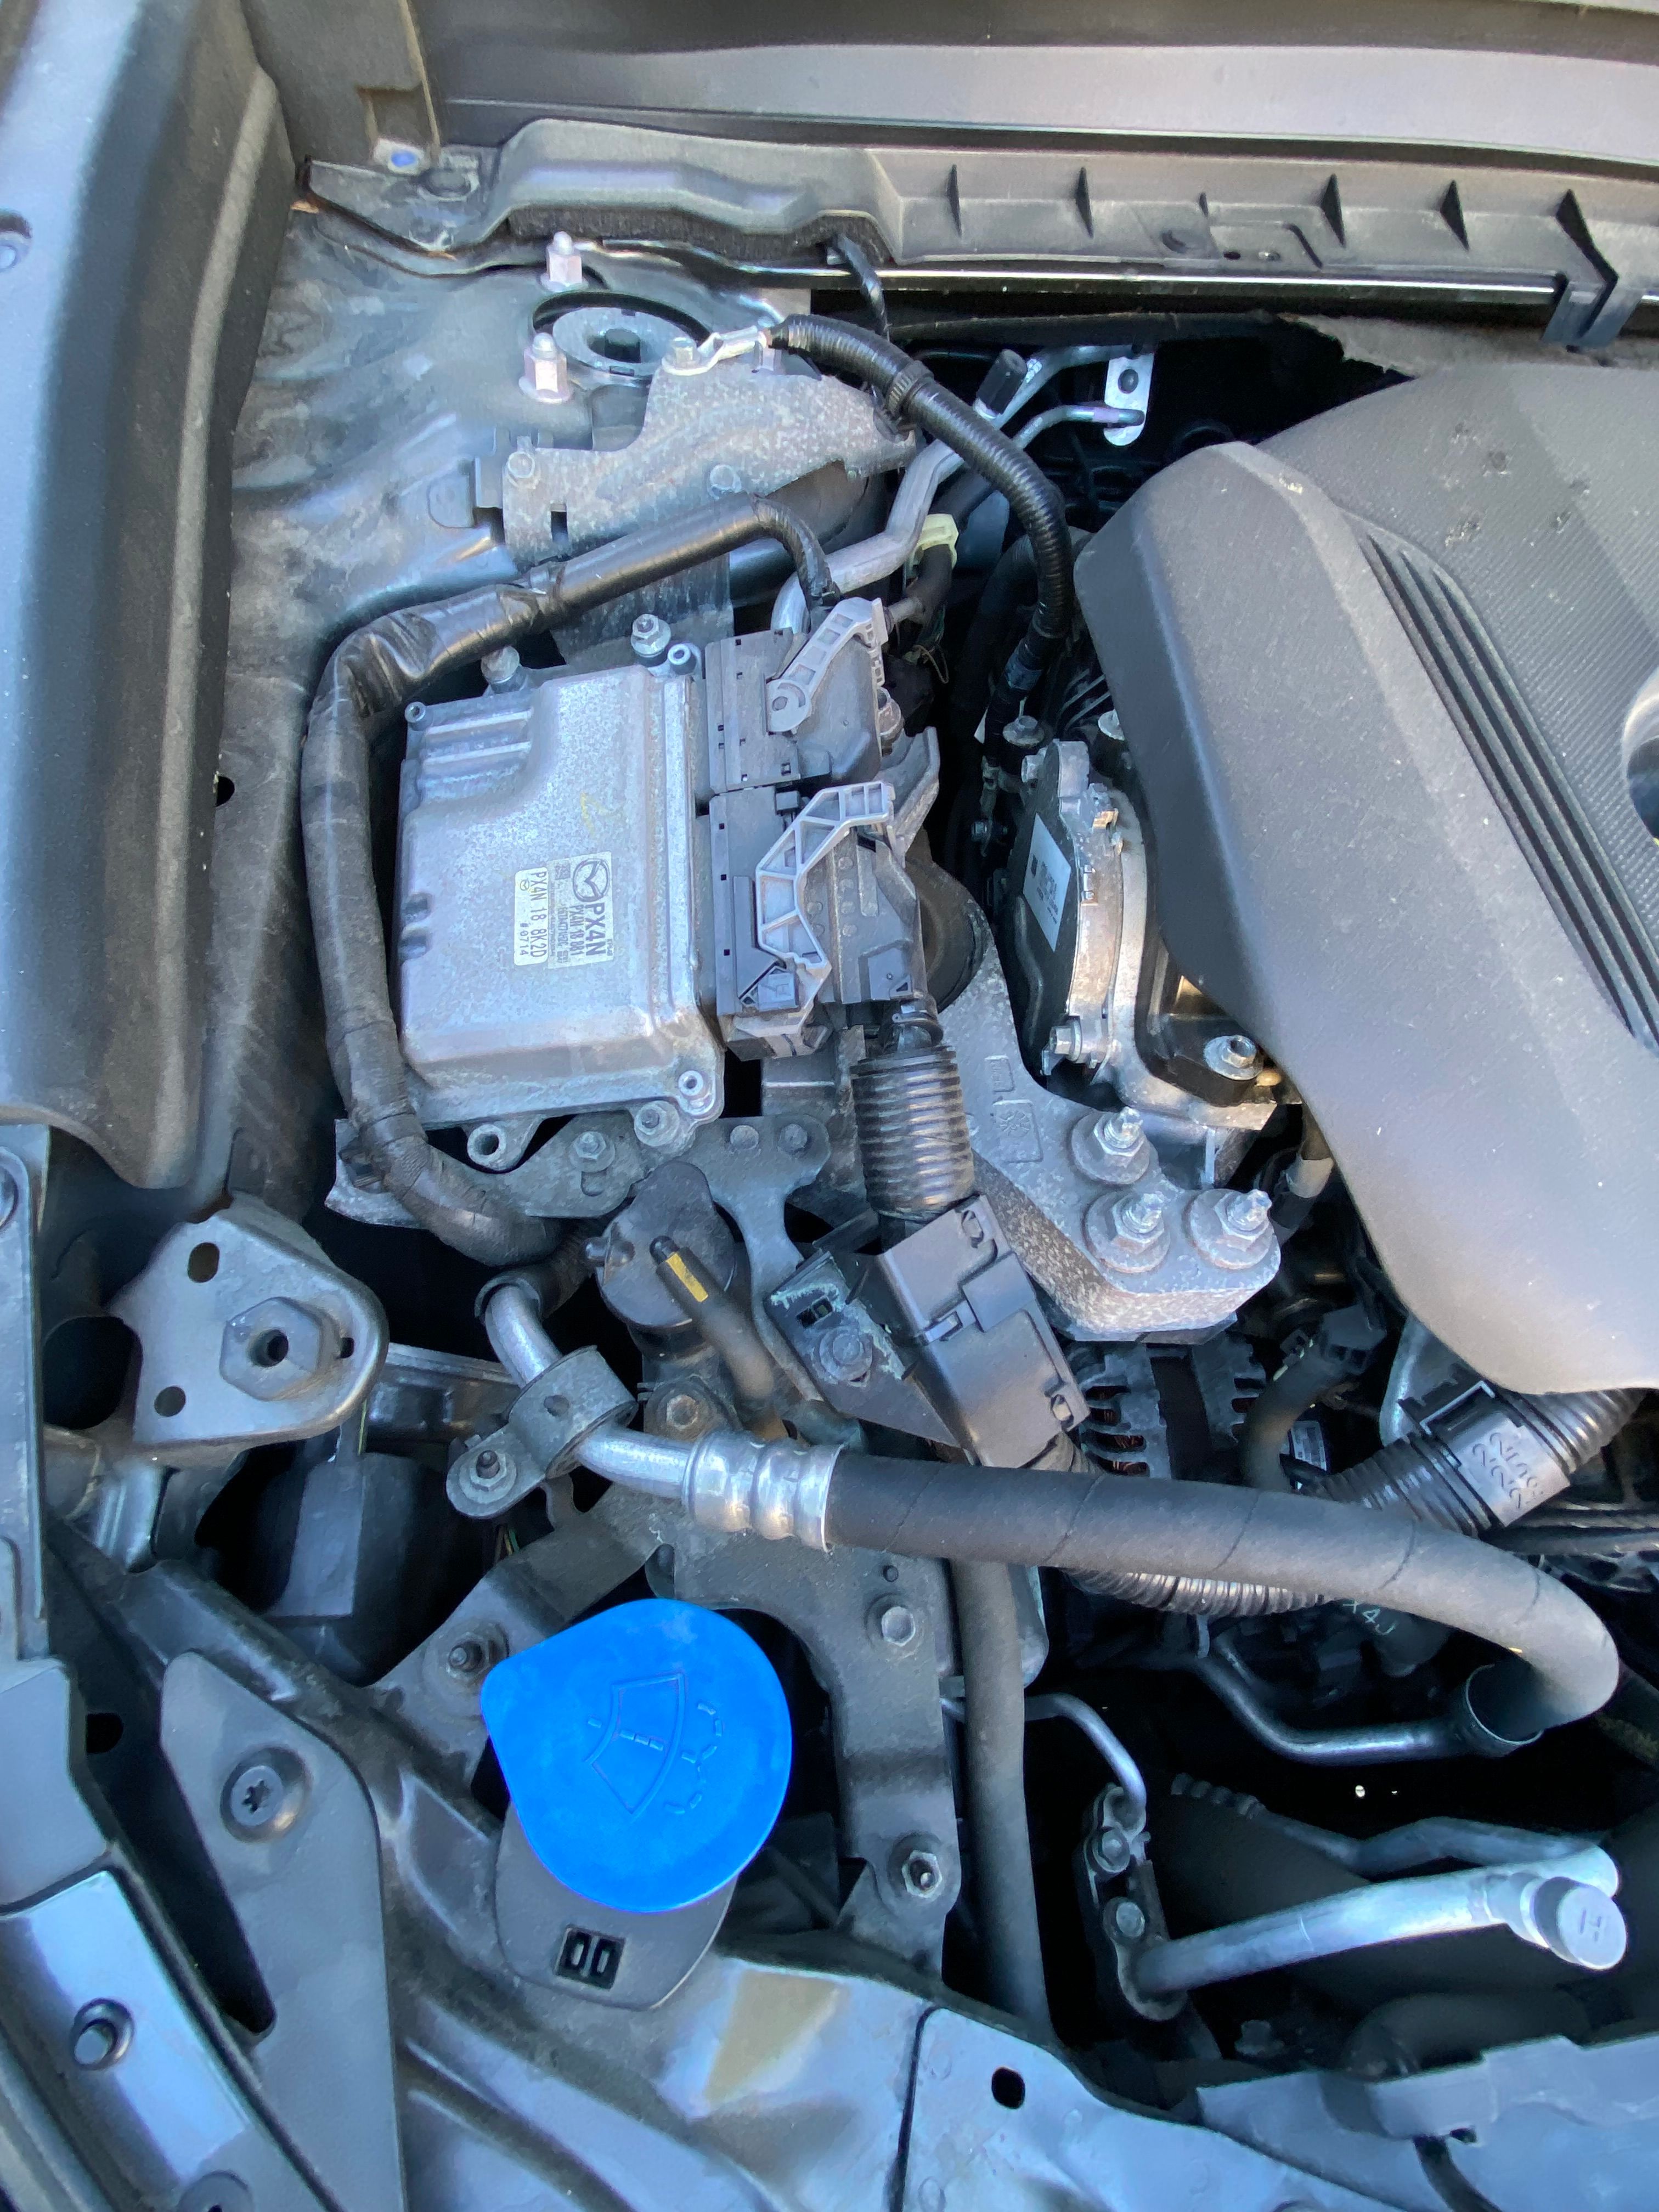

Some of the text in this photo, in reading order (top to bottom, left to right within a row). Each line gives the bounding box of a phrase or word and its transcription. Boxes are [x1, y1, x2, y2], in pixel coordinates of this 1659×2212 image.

[529, 871, 547, 957] PX4N 18 8K2D
[569, 905, 584, 956] PX4N 18 881
[585, 902, 606, 956] PX4N
